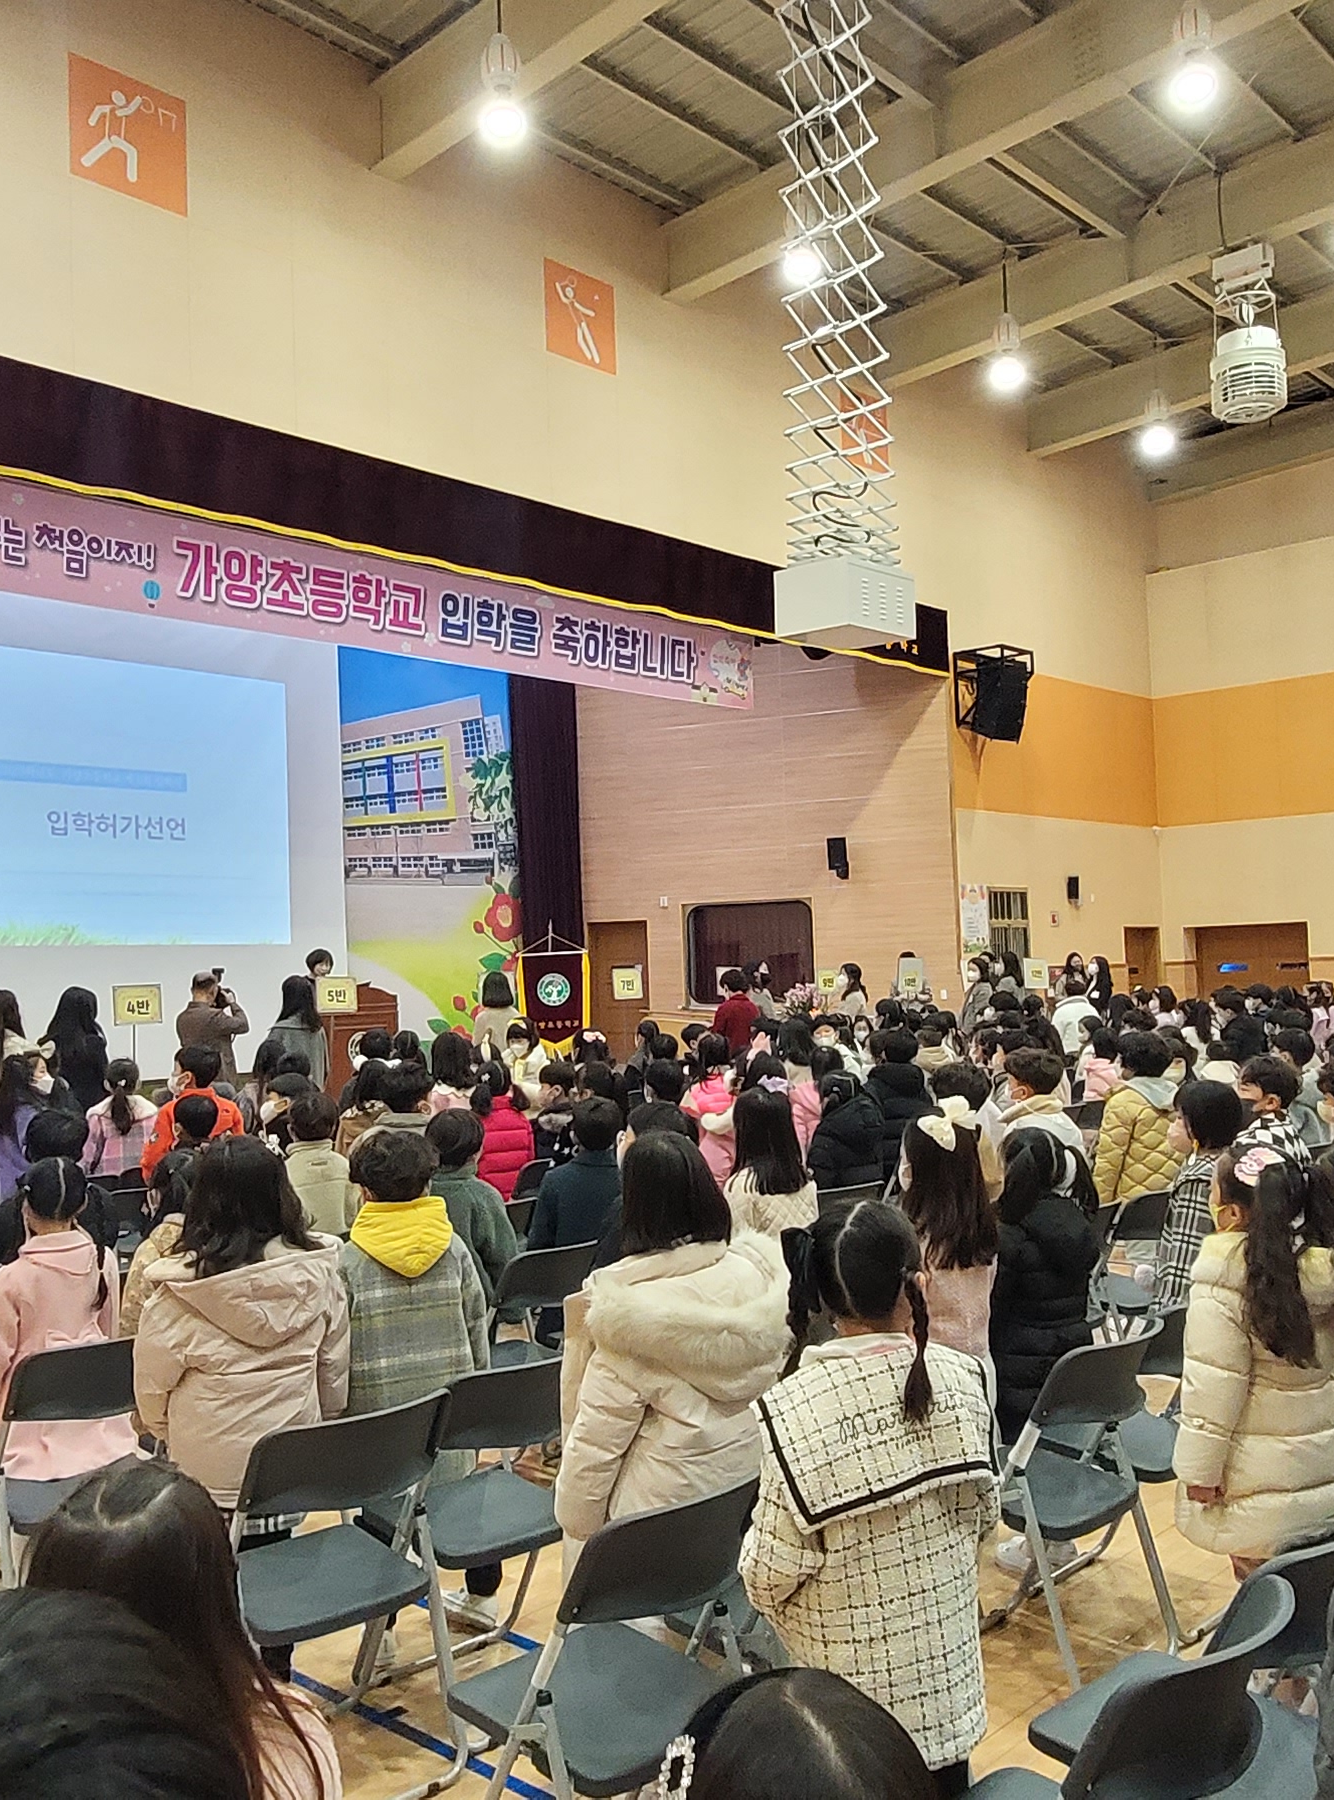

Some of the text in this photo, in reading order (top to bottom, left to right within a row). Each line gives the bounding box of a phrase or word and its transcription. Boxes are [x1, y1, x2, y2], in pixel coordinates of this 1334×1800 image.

[33, 520, 158, 578] 처음이지!
[173, 535, 427, 636] 가양초등학교
[438, 590, 543, 658] 입학을
[551, 612, 698, 684] 축하합니다
[620, 979, 635, 991] 7반
[327, 989, 347, 1003] 5반
[126, 999, 150, 1015] 4반
